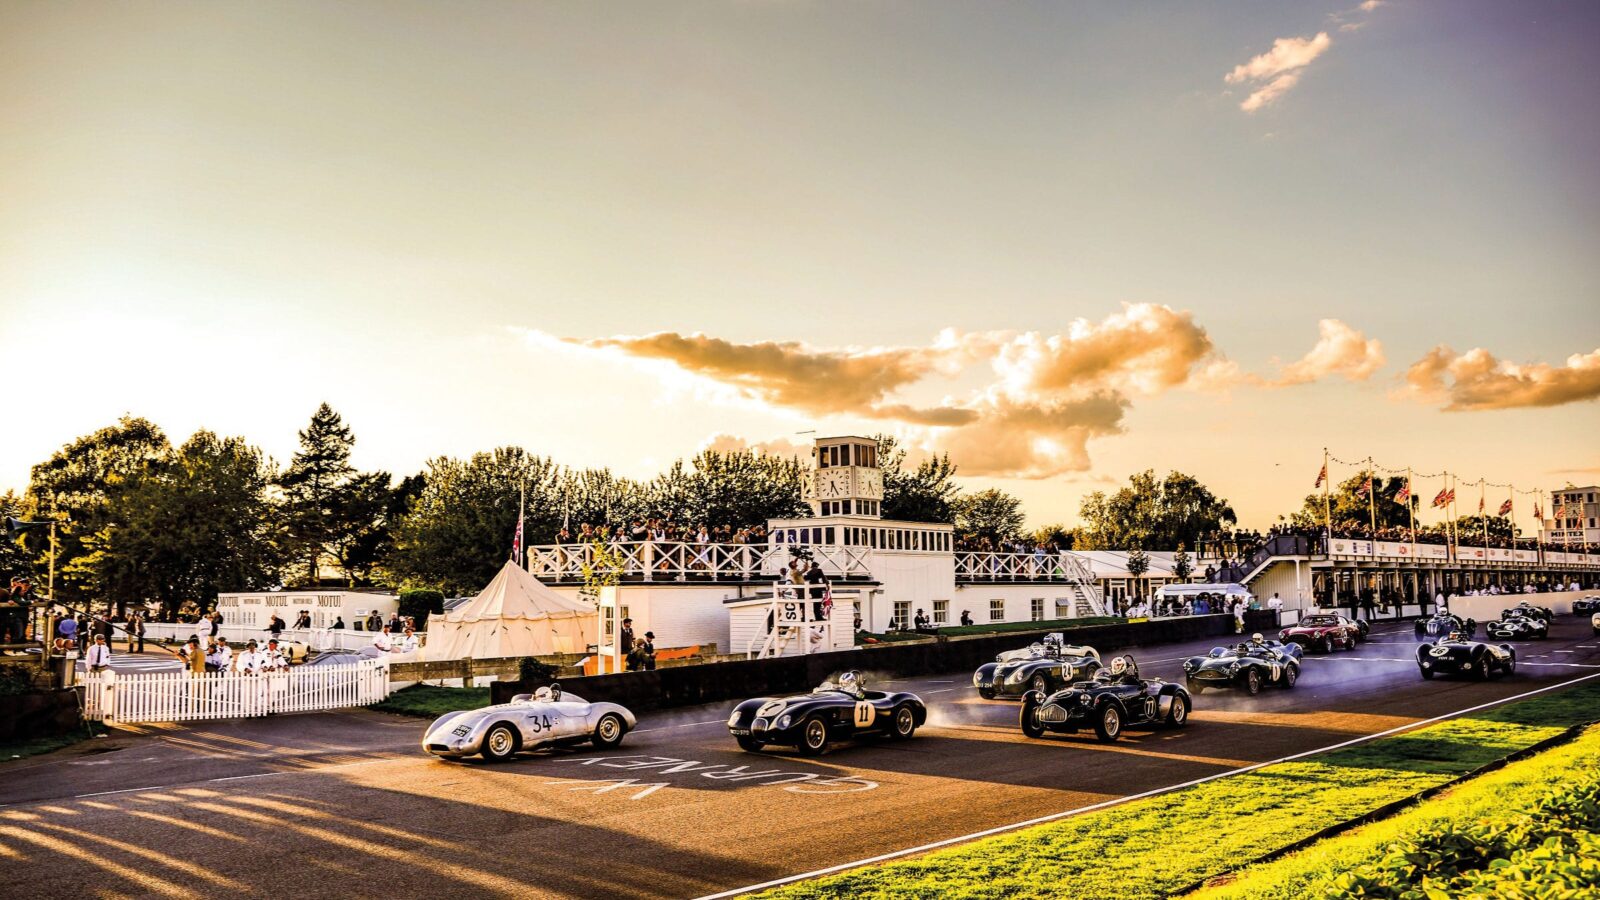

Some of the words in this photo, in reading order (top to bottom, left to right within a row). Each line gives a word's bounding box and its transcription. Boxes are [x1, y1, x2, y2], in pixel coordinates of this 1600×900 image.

[219, 596, 239, 607] MOTUL
[265, 595, 288, 607] MOTUL
[858, 704, 869, 723] 11
[1146, 700, 1154, 715] 77
[527, 714, 552, 733] 34
[552, 754, 879, 794] GURNEY
